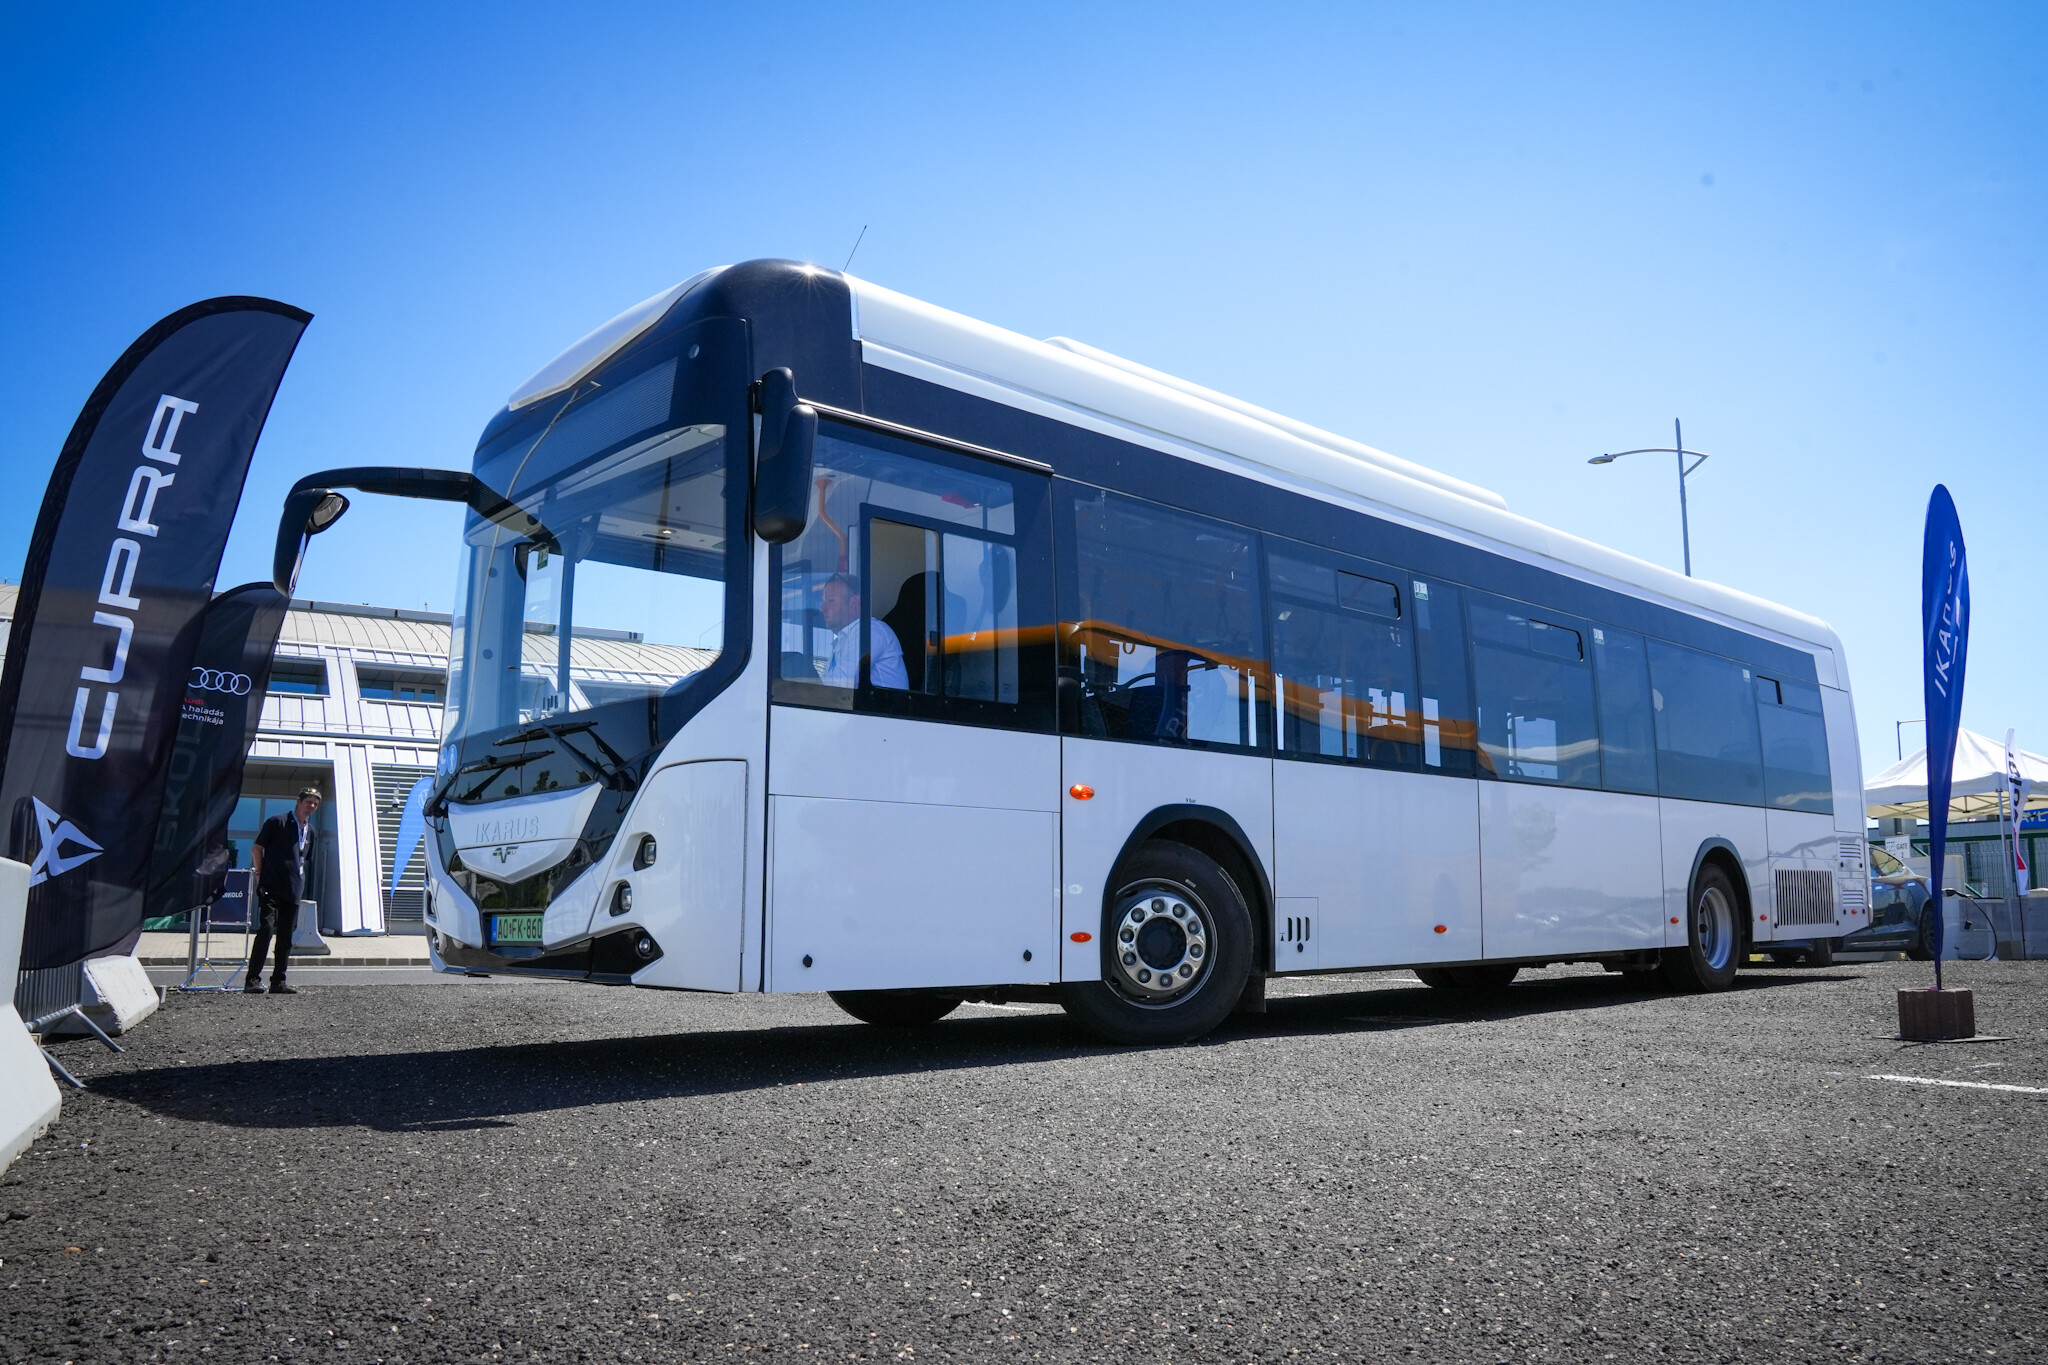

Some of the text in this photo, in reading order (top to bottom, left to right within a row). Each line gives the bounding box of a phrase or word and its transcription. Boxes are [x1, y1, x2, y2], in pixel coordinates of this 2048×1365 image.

[65, 394, 200, 760] CUPRA
[181, 713, 224, 725] echnikája
[189, 705, 224, 717] haladás
[475, 815, 539, 843] IKARUS
